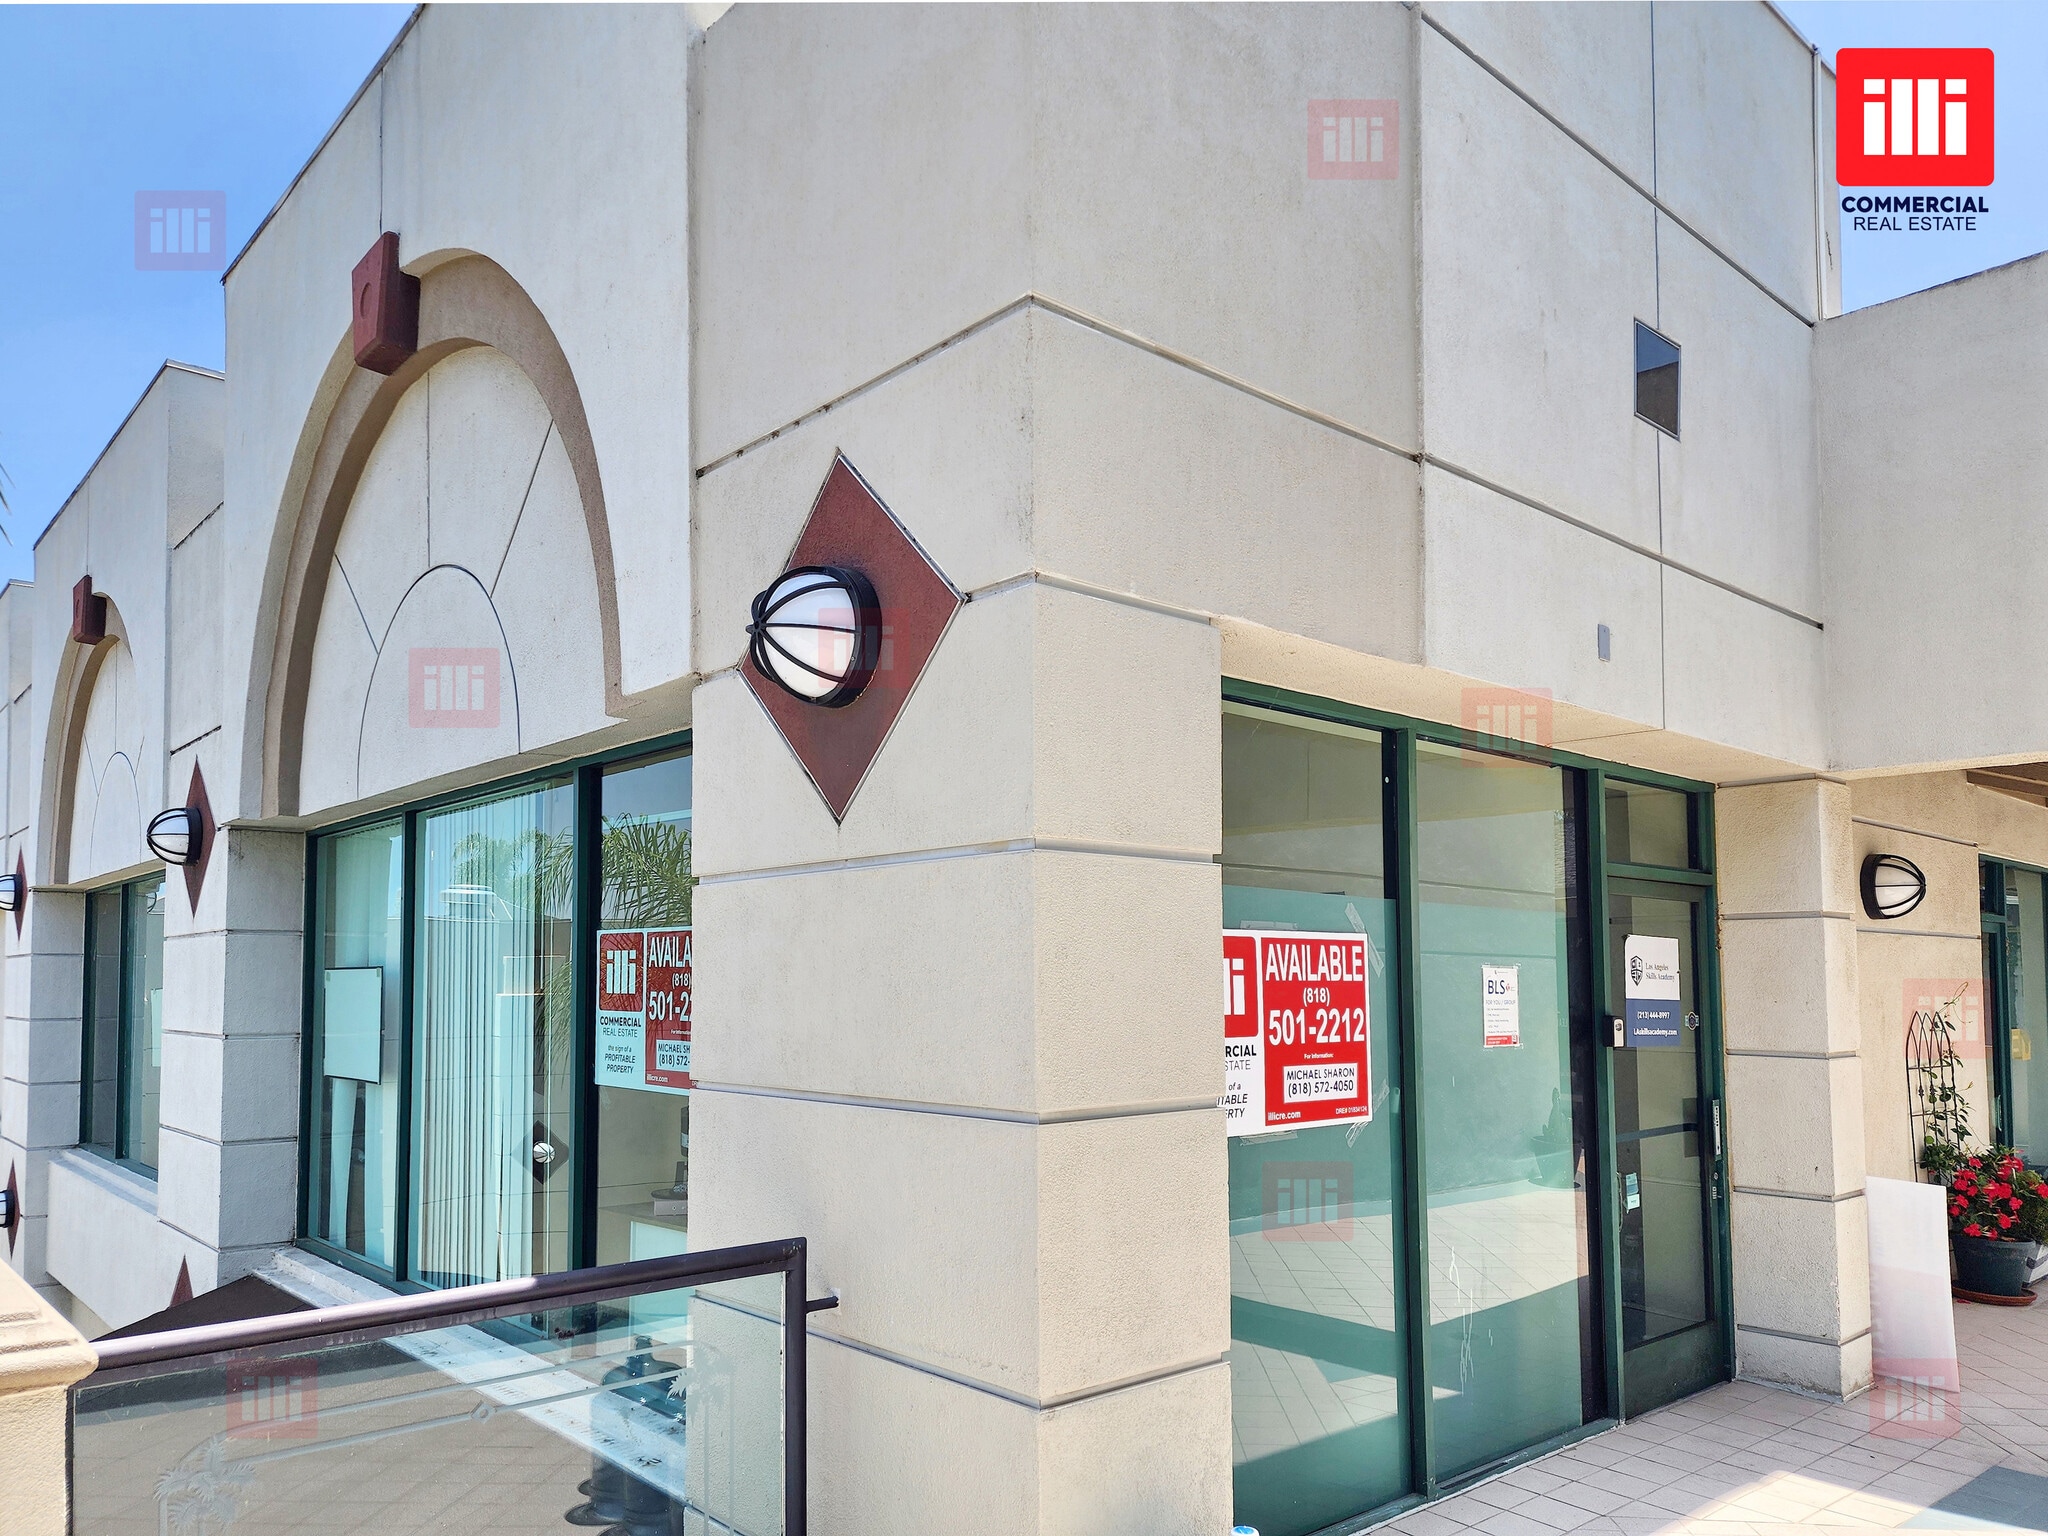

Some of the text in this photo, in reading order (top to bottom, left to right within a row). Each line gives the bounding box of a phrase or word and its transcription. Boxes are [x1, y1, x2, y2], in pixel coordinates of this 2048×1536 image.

[648, 936, 692, 967] AVAILA
[1265, 943, 1363, 981] AVAILABLE
[1645, 962, 1653, 970] Los
[606, 949, 637, 995] illi
[1645, 971, 1657, 980] Skills
[1487, 979, 1506, 995] BLS
[1303, 986, 1331, 1007] (818)
[648, 990, 692, 1022] 501-2
[600, 1015, 642, 1028] COMMERCIAL
[1636, 1011, 1649, 1020] (213)
[602, 1027, 638, 1038] REAL ESTATE
[1268, 1007, 1365, 1046] 501-2212
[615, 1044, 624, 1053] sign
[624, 1045, 629, 1053] of
[658, 1043, 682, 1054] MICHAEL
[604, 1053, 636, 1064] PROFITABLE
[659, 1053, 690, 1067] (818) 572-
[606, 1063, 634, 1074] PROPERTY
[1286, 1067, 1355, 1081] MICHAEL SHARON
[1228, 1081, 1236, 1091] of
[1288, 1079, 1354, 1098] (818) 572-4050
[1267, 1111, 1301, 1121] illicre.com
